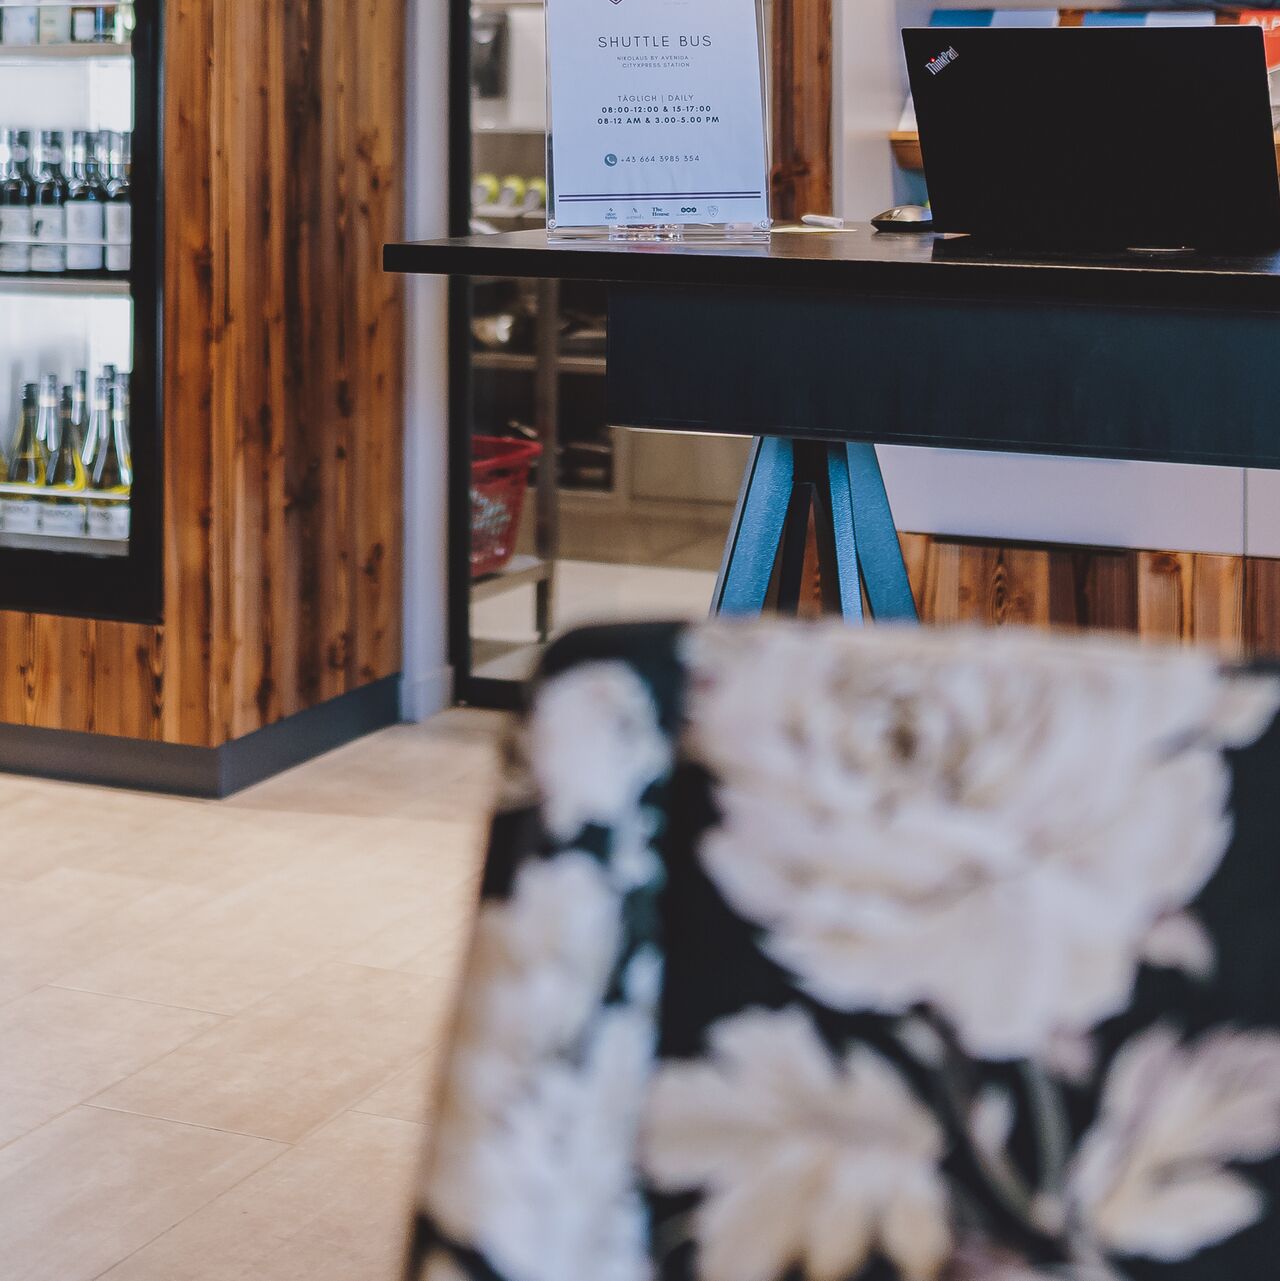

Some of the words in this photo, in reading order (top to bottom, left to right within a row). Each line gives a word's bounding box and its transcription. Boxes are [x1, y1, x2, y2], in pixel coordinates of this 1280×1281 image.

[598, 35, 670, 48] SHUTTLE
[679, 35, 712, 47] BUS
[924, 45, 959, 76] ThinkPad
[667, 94, 694, 102] DAILY
[672, 105, 711, 113] 15-17:00
[597, 117, 622, 125] 08-12
[654, 116, 702, 124] 3.00-5.00
